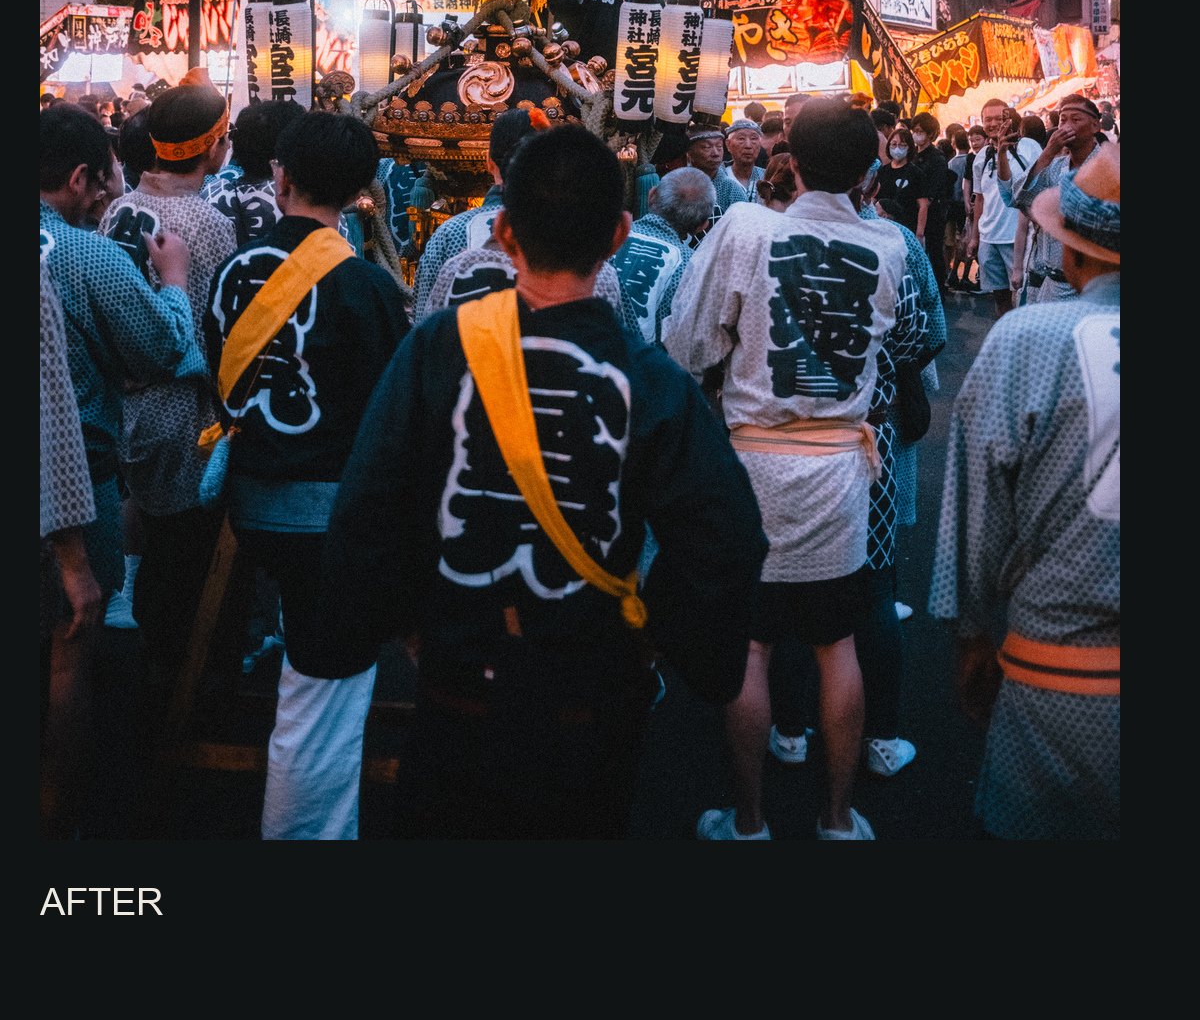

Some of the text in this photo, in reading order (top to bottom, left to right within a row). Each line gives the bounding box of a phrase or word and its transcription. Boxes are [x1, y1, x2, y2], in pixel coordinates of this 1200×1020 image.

[274, 9, 293, 45] 長崎
[627, 8, 648, 44] 神社
[681, 11, 701, 47] 神社
[621, 44, 659, 114] 宮元
